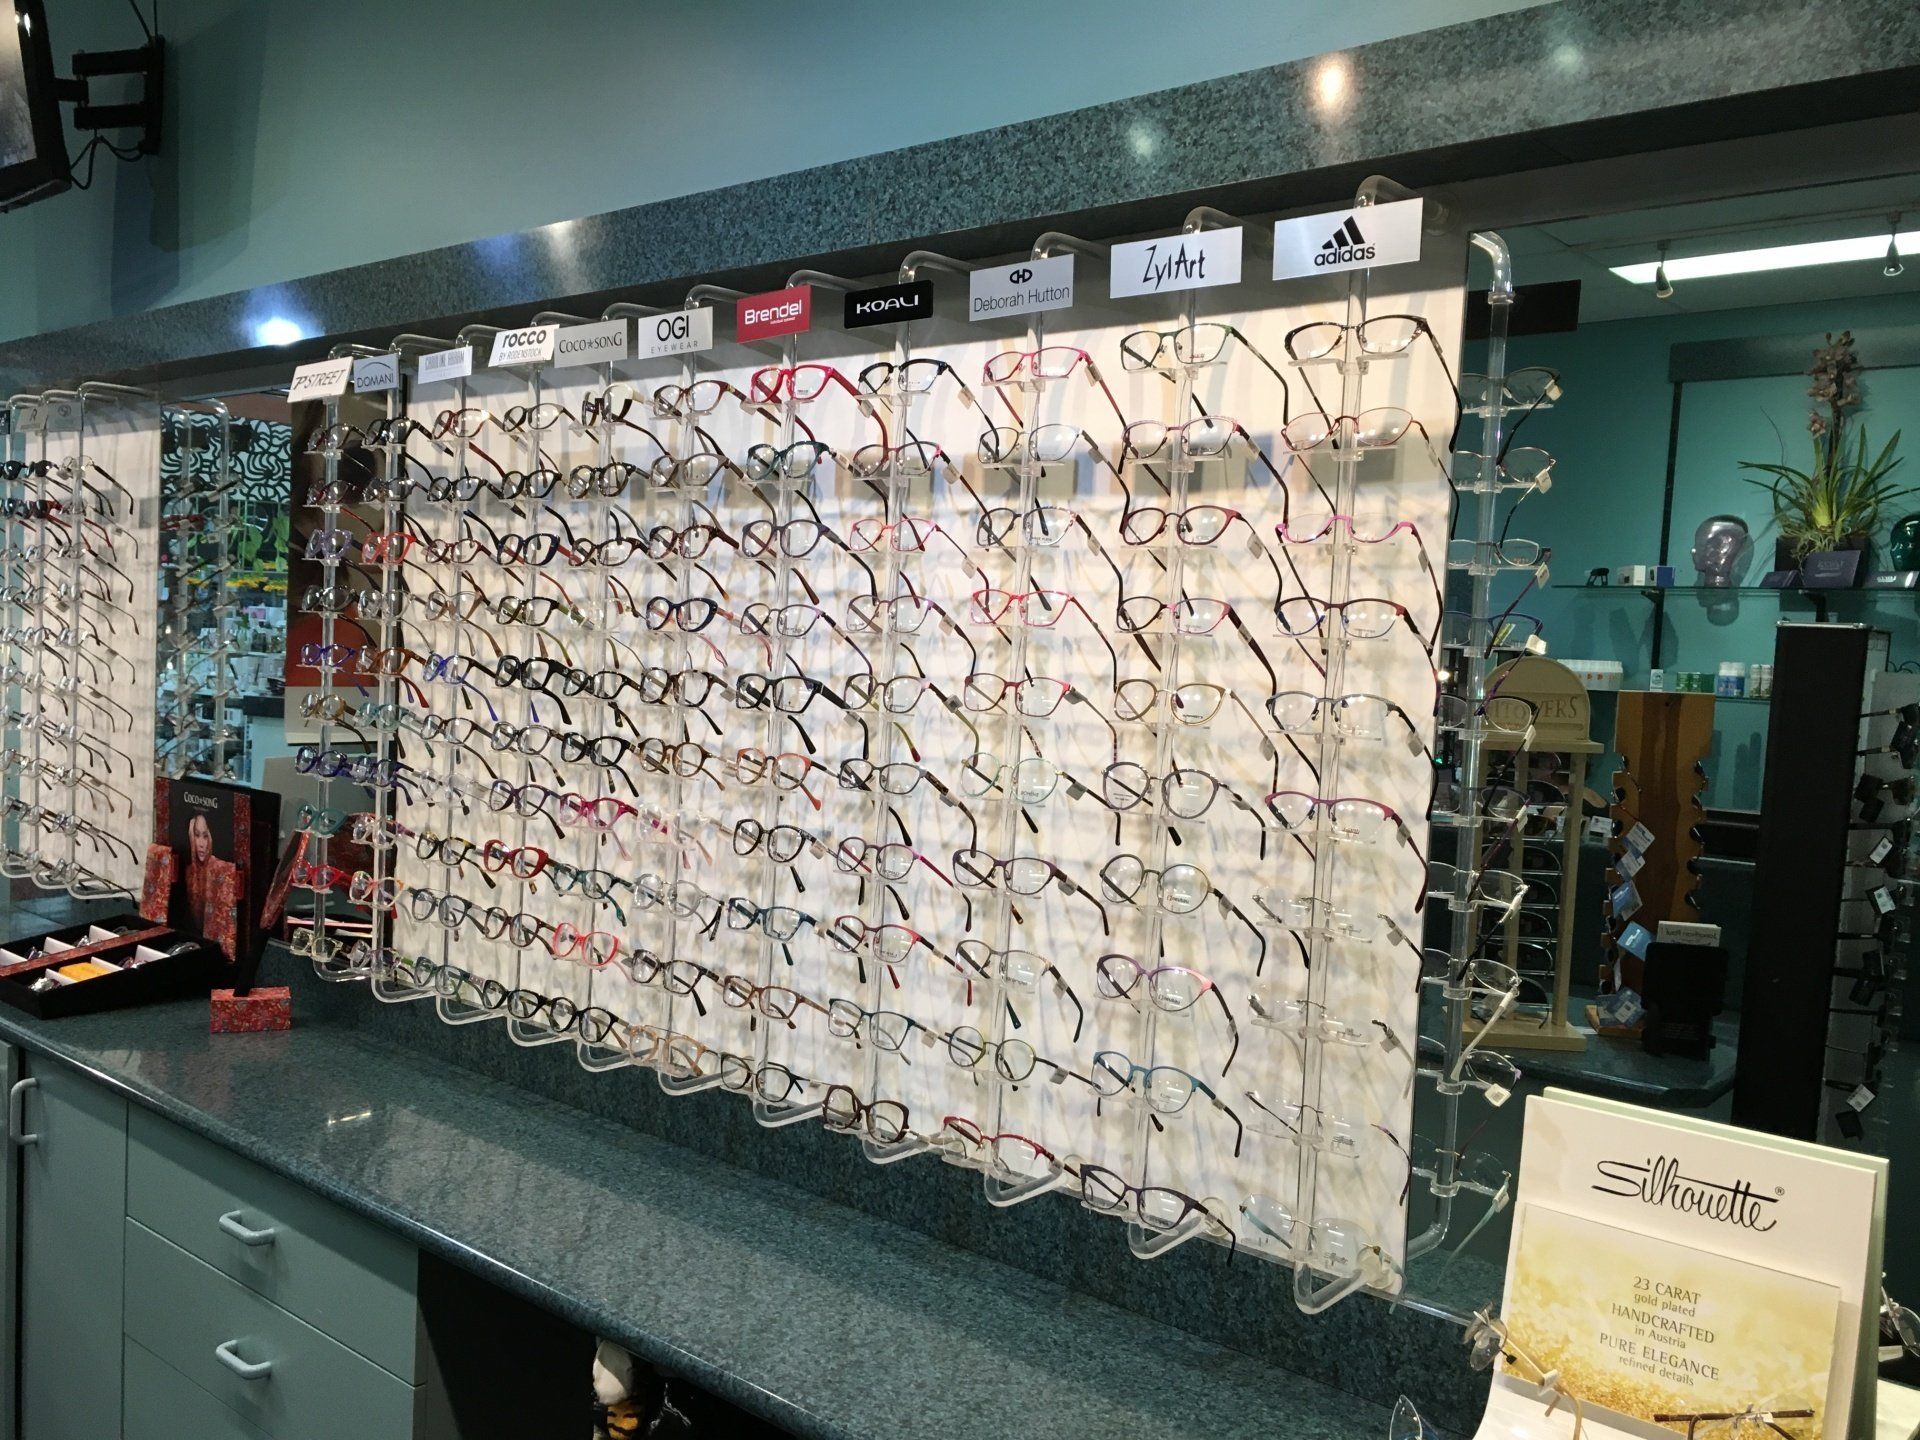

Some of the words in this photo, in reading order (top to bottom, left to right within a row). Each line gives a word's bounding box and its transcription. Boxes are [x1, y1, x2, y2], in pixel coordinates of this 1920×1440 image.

[1142, 243, 1206, 291] ZylArt
[1314, 244, 1375, 267] adidas
[744, 299, 802, 325] Brendel
[856, 294, 919, 314] KOALI
[974, 292, 1024, 313] Deborah
[1028, 286, 1070, 304] Hutton
[502, 329, 547, 348] rocco
[656, 315, 689, 341] OGI
[499, 352, 506, 361] BY
[651, 341, 699, 354] EYEWEAR
[357, 373, 394, 388] DOMANI
[1591, 1155, 1779, 1232] Silhouette
[1633, 1276, 1650, 1290] 23
[1656, 1282, 1701, 1304] CARAT
[1634, 1293, 1657, 1306] gold
[1662, 1301, 1695, 1317] plated
[1612, 1303, 1714, 1343] HANDCRAFTED
[1635, 1325, 1645, 1336] in
[1648, 1330, 1686, 1349] Austria
[1600, 1332, 1636, 1354] PURE
[1642, 1346, 1720, 1381] ELEGANCE
[1620, 1356, 1655, 1374] refined
[1660, 1367, 1694, 1386] details
